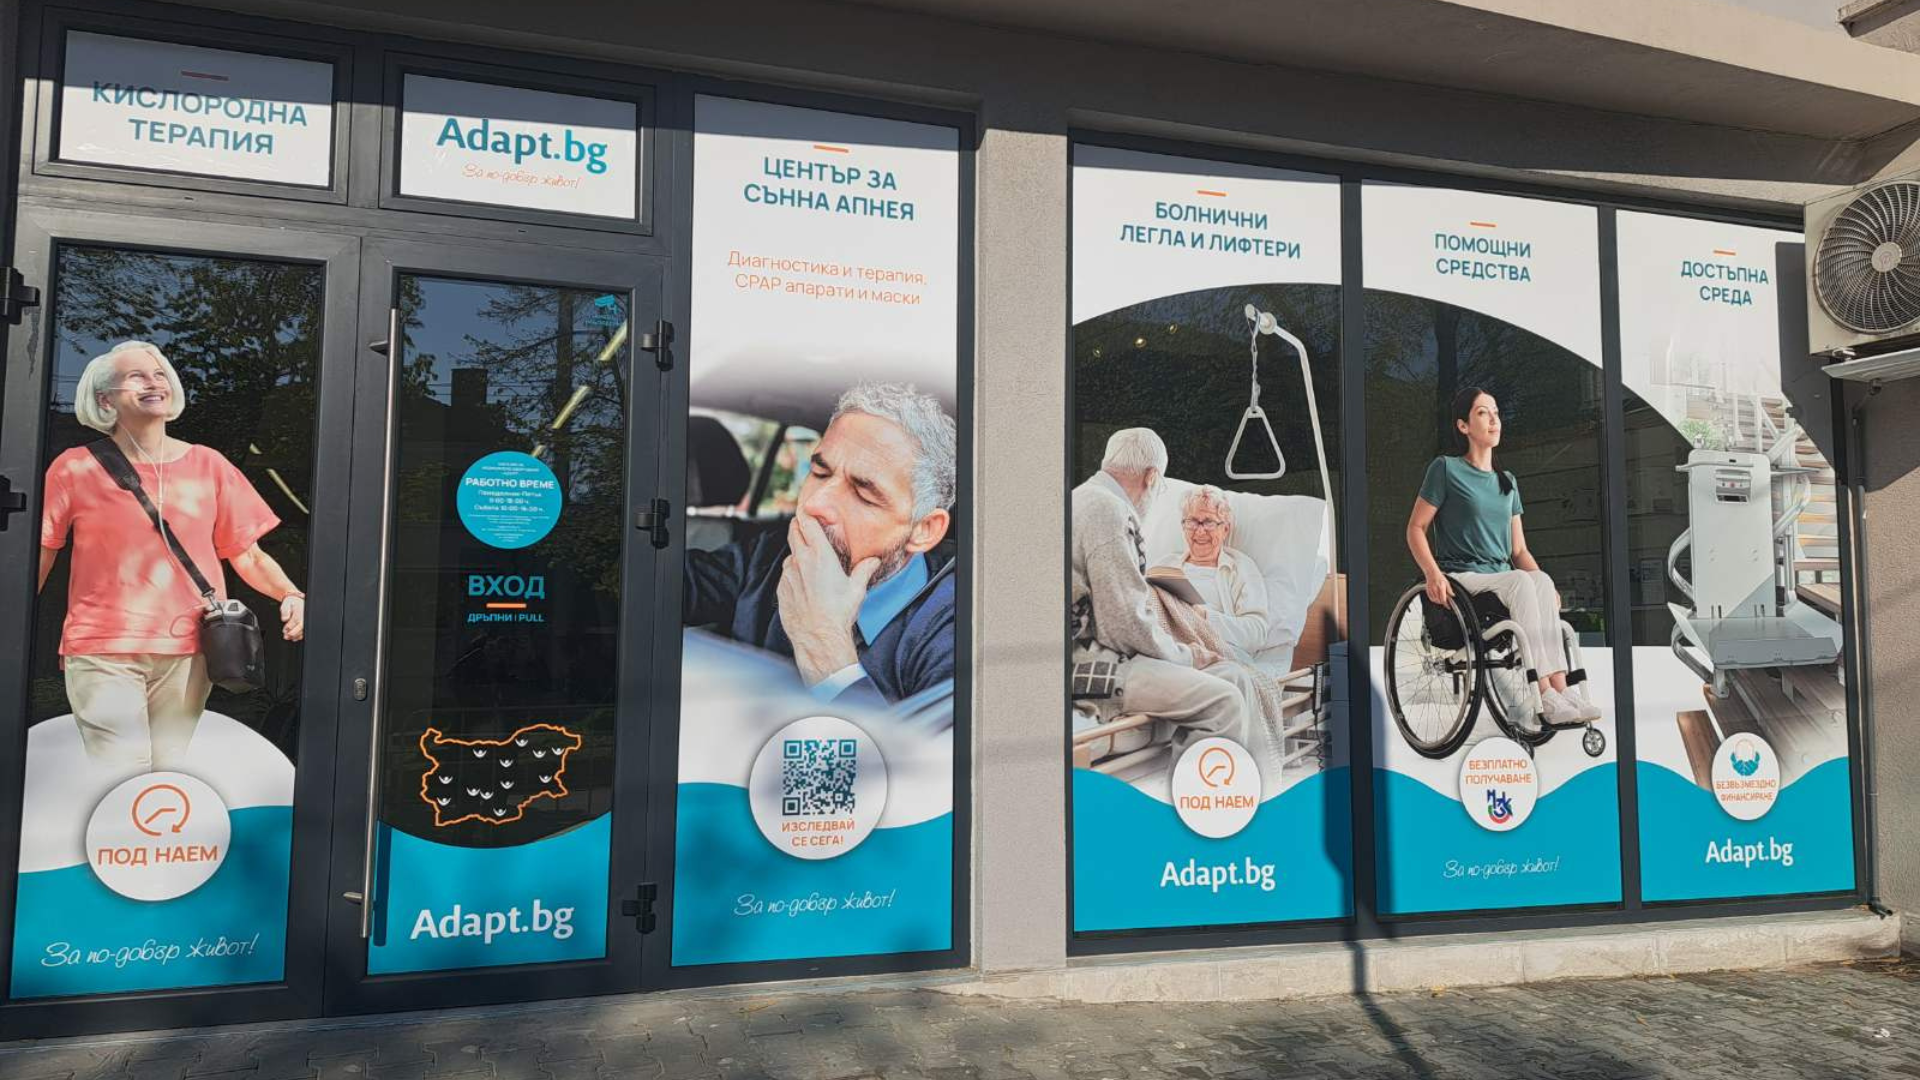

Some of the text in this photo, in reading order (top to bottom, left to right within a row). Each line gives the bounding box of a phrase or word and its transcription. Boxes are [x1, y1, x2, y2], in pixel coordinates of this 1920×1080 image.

[92, 81, 307, 126] КИСЛОРОДНА
[128, 118, 273, 154] ТЕРАПИЯ
[436, 118, 607, 174] Adapt.bg
[764, 157, 897, 190] ЦЕНТЪР ЗА
[744, 183, 914, 221] СЪННА АПНЕЯ
[1156, 201, 1268, 230] БОЛНИЧНИ
[1120, 224, 1301, 260] ЛЕГЛА И ЛИФТЕРИ
[1435, 233, 1531, 258] ПОМОЩНИ
[727, 250, 839, 276] Диагностика
[843, 267, 852, 277] и
[1436, 258, 1531, 282] СРЕДСТВА
[1681, 261, 1768, 285] ДОСТЪПНА
[735, 274, 920, 304] CPAP апарати и маски
[1699, 285, 1752, 306] СРЕДА
[465, 477, 555, 489] РАБОТНО ВРЕМЕ
[468, 575, 545, 599] ВХОД
[467, 613, 544, 622] ДРЪПНИ PULL
[1469, 759, 1528, 770] БЕЗПЛАТНО
[1465, 773, 1532, 784] ПОЛУЧАВАНЕ
[1180, 795, 1254, 810] ПОД НАЕМ
[781, 818, 855, 832] ИЗСЛЕДВАЙ
[791, 835, 844, 847] СЕ СЕГА!
[1705, 836, 1793, 868] Adapt.bg
[98, 845, 218, 866] ПОД НАЕМ
[1160, 856, 1276, 893] Adapt.bg
[1443, 860, 1464, 878] За
[734, 894, 763, 915] За
[841, 889, 896, 910] живот!
[410, 899, 574, 944] Adapt.bg
[41, 941, 81, 967] За
[186, 932, 260, 959] живот!
